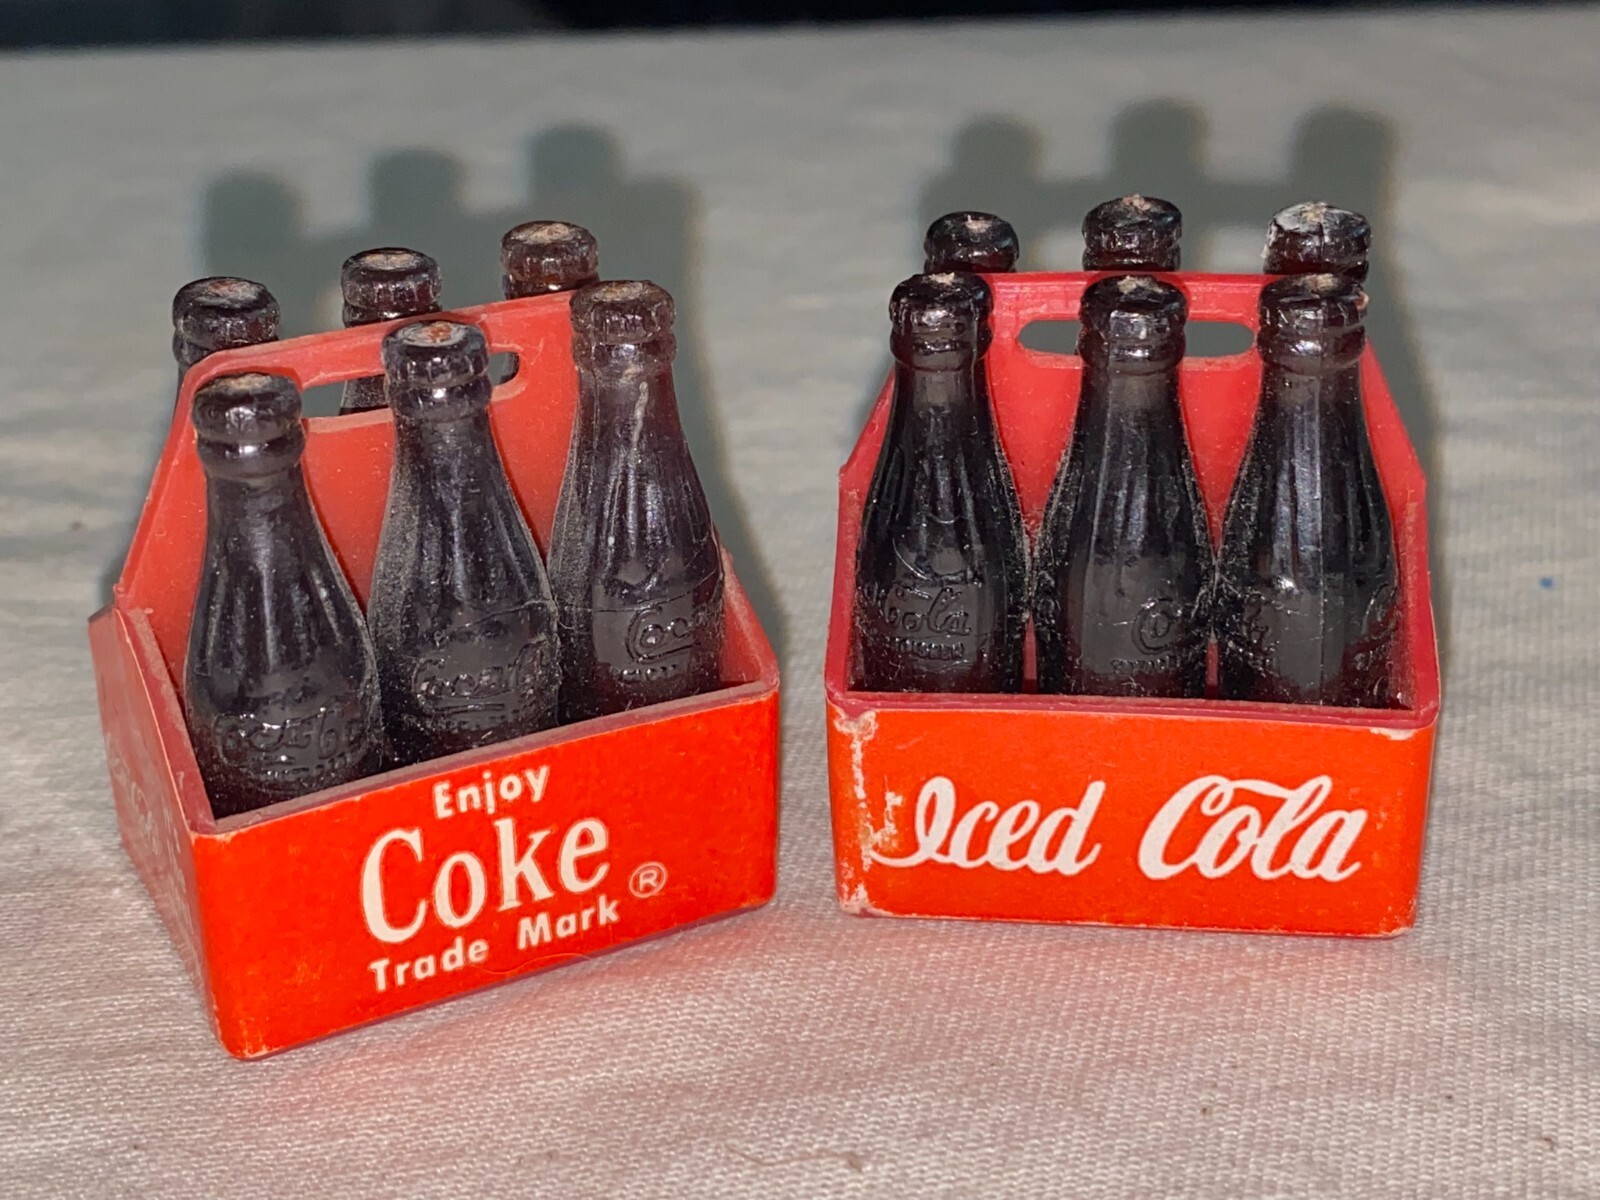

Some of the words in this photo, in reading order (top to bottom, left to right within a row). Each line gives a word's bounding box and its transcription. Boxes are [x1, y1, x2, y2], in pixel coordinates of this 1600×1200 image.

[432, 764, 551, 821] Enjoy
[868, 776, 1106, 876] Iced
[1138, 775, 1368, 882] Cola
[361, 817, 610, 943] Coke
[369, 936, 490, 992] Trade
[516, 895, 621, 950] Mark
